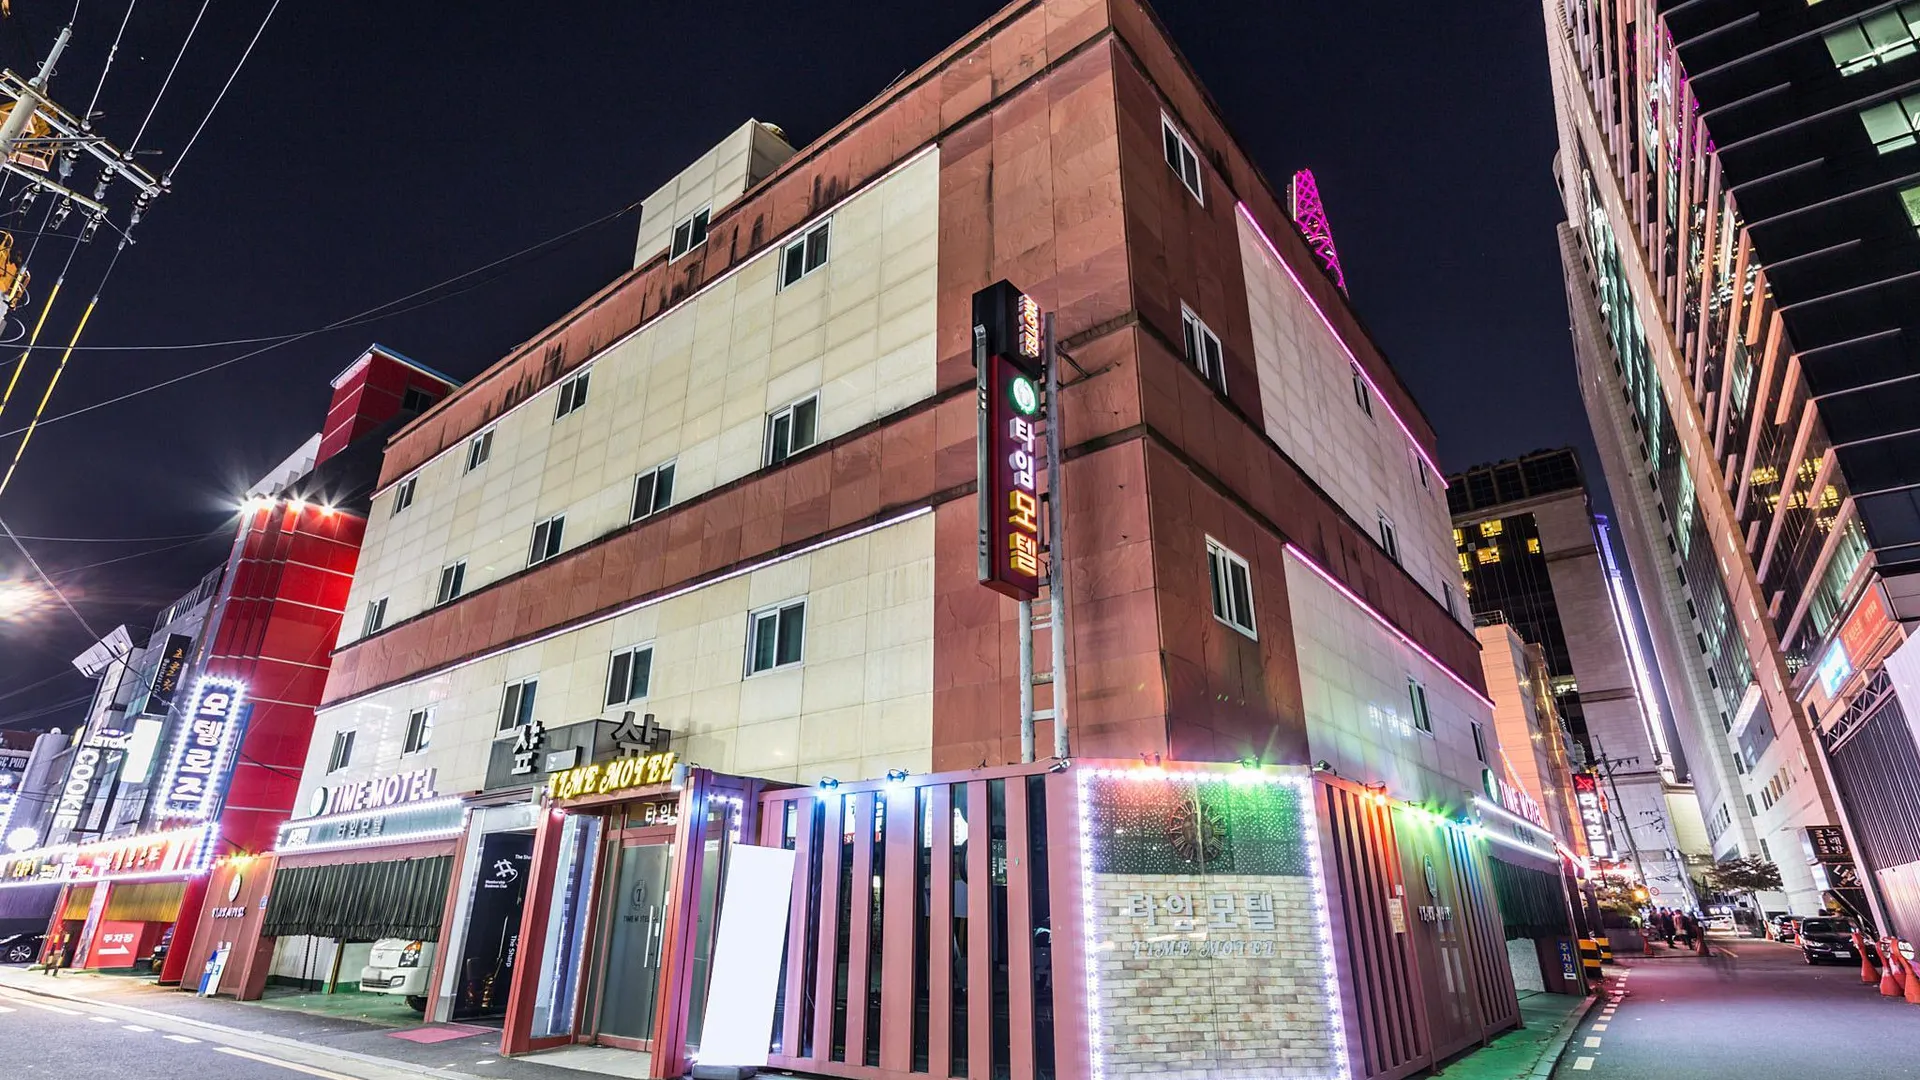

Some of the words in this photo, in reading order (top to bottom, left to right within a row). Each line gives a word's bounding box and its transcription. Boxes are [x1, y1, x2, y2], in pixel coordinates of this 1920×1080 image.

[1020, 293, 1039, 357] MOTEL
[8, 757, 27, 769] PUB
[547, 765, 599, 799] TIME
[599, 752, 677, 794] MOTEL
[52, 749, 99, 829] COOKIE
[327, 781, 368, 815] TIME
[367, 768, 438, 809] MOTEL
[505, 947, 516, 968] Sharp
[509, 935, 518, 947] The
[1132, 940, 1191, 958] TIME
[1201, 939, 1276, 958] MOTEL
